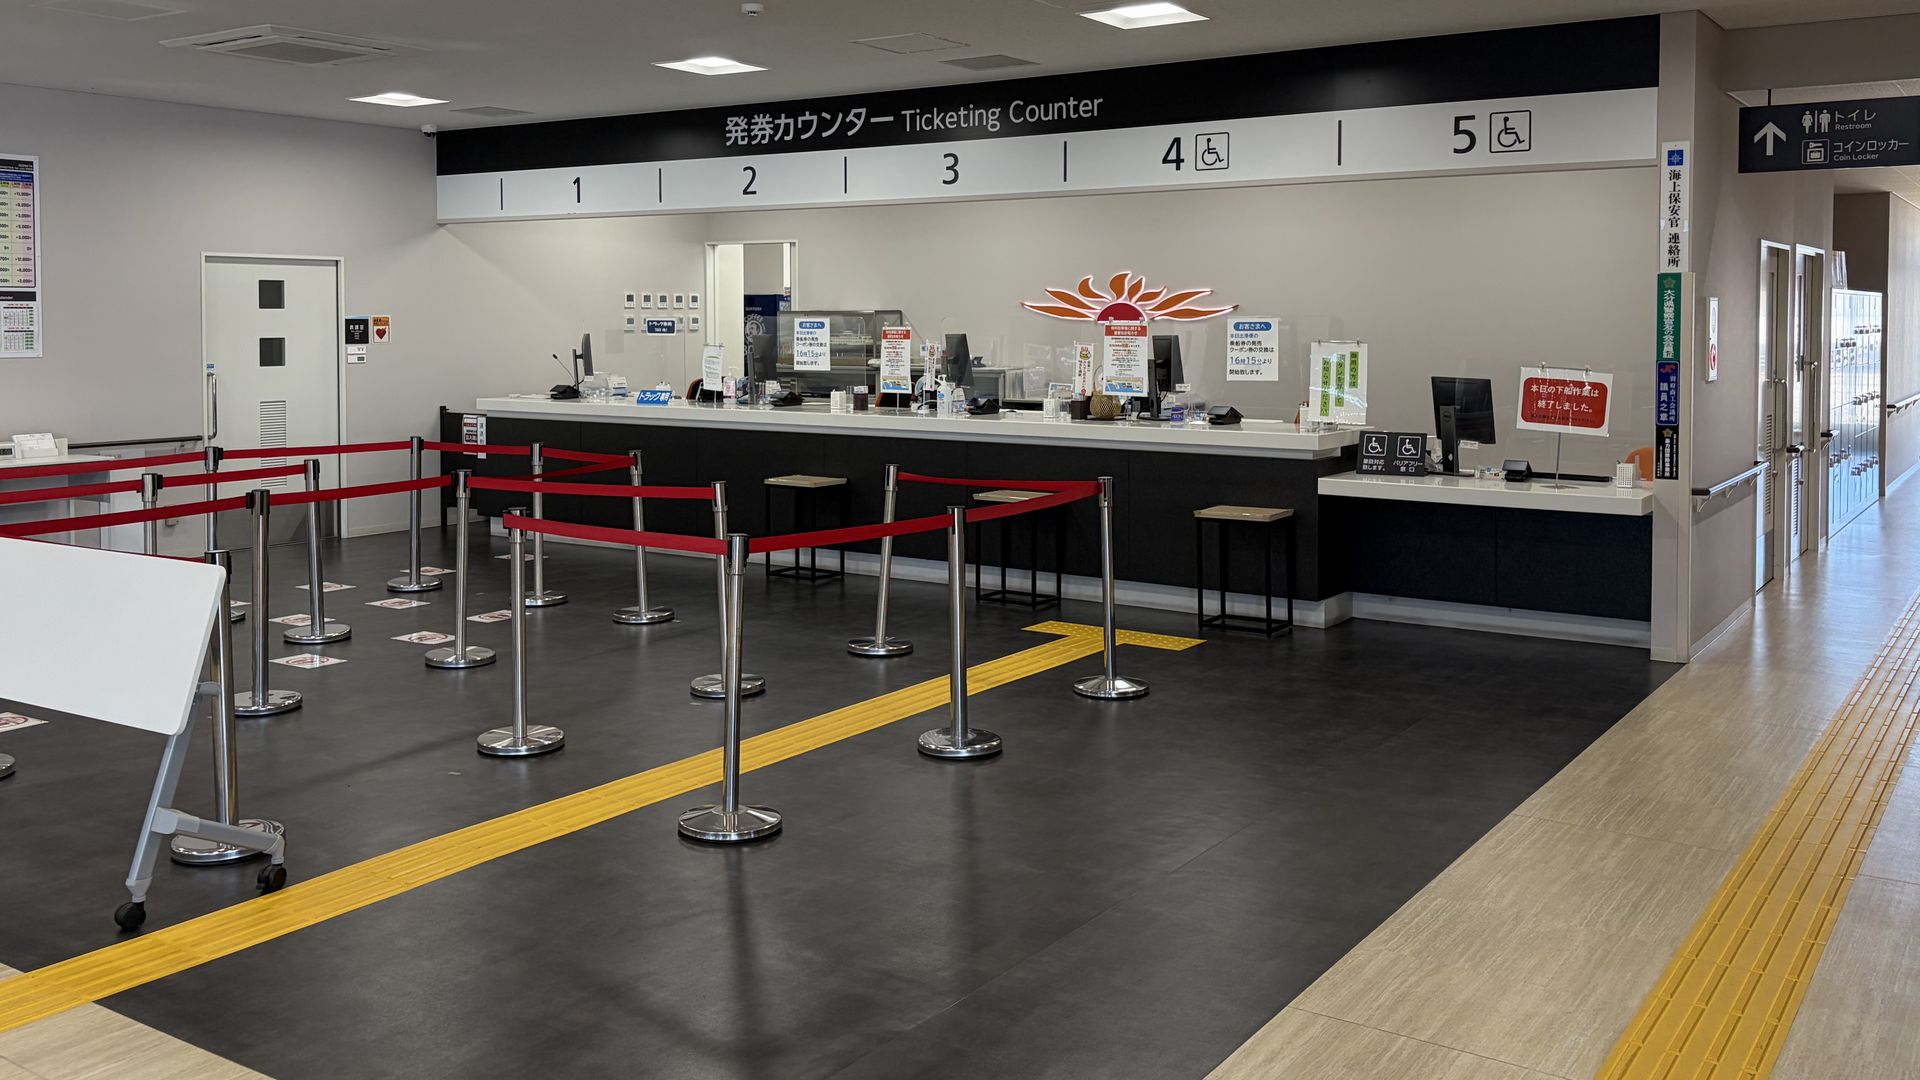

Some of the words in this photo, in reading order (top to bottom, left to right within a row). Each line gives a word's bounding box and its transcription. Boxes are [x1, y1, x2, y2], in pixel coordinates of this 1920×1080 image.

[725, 107, 894, 146] 発券カウンター
[901, 104, 1001, 132] Ticketing
[1009, 97, 1104, 124] Counter
[1835, 109, 1877, 122] トイレ
[1453, 115, 1477, 154] 5
[1833, 139, 1910, 153] コインロッカー
[1162, 137, 1184, 171] 4
[1852, 153, 1879, 161] Locker
[742, 166, 757, 195] 2
[942, 153, 960, 185] 3
[572, 177, 581, 203] 1
[1668, 169, 1682, 228] 海上保安官
[1667, 232, 1681, 268] 連絡所
[1230, 356, 1273, 365] 16時15分より
[1530, 384, 1600, 397] 本日の下船作業は
[1537, 400, 1593, 413] 終了しました。
